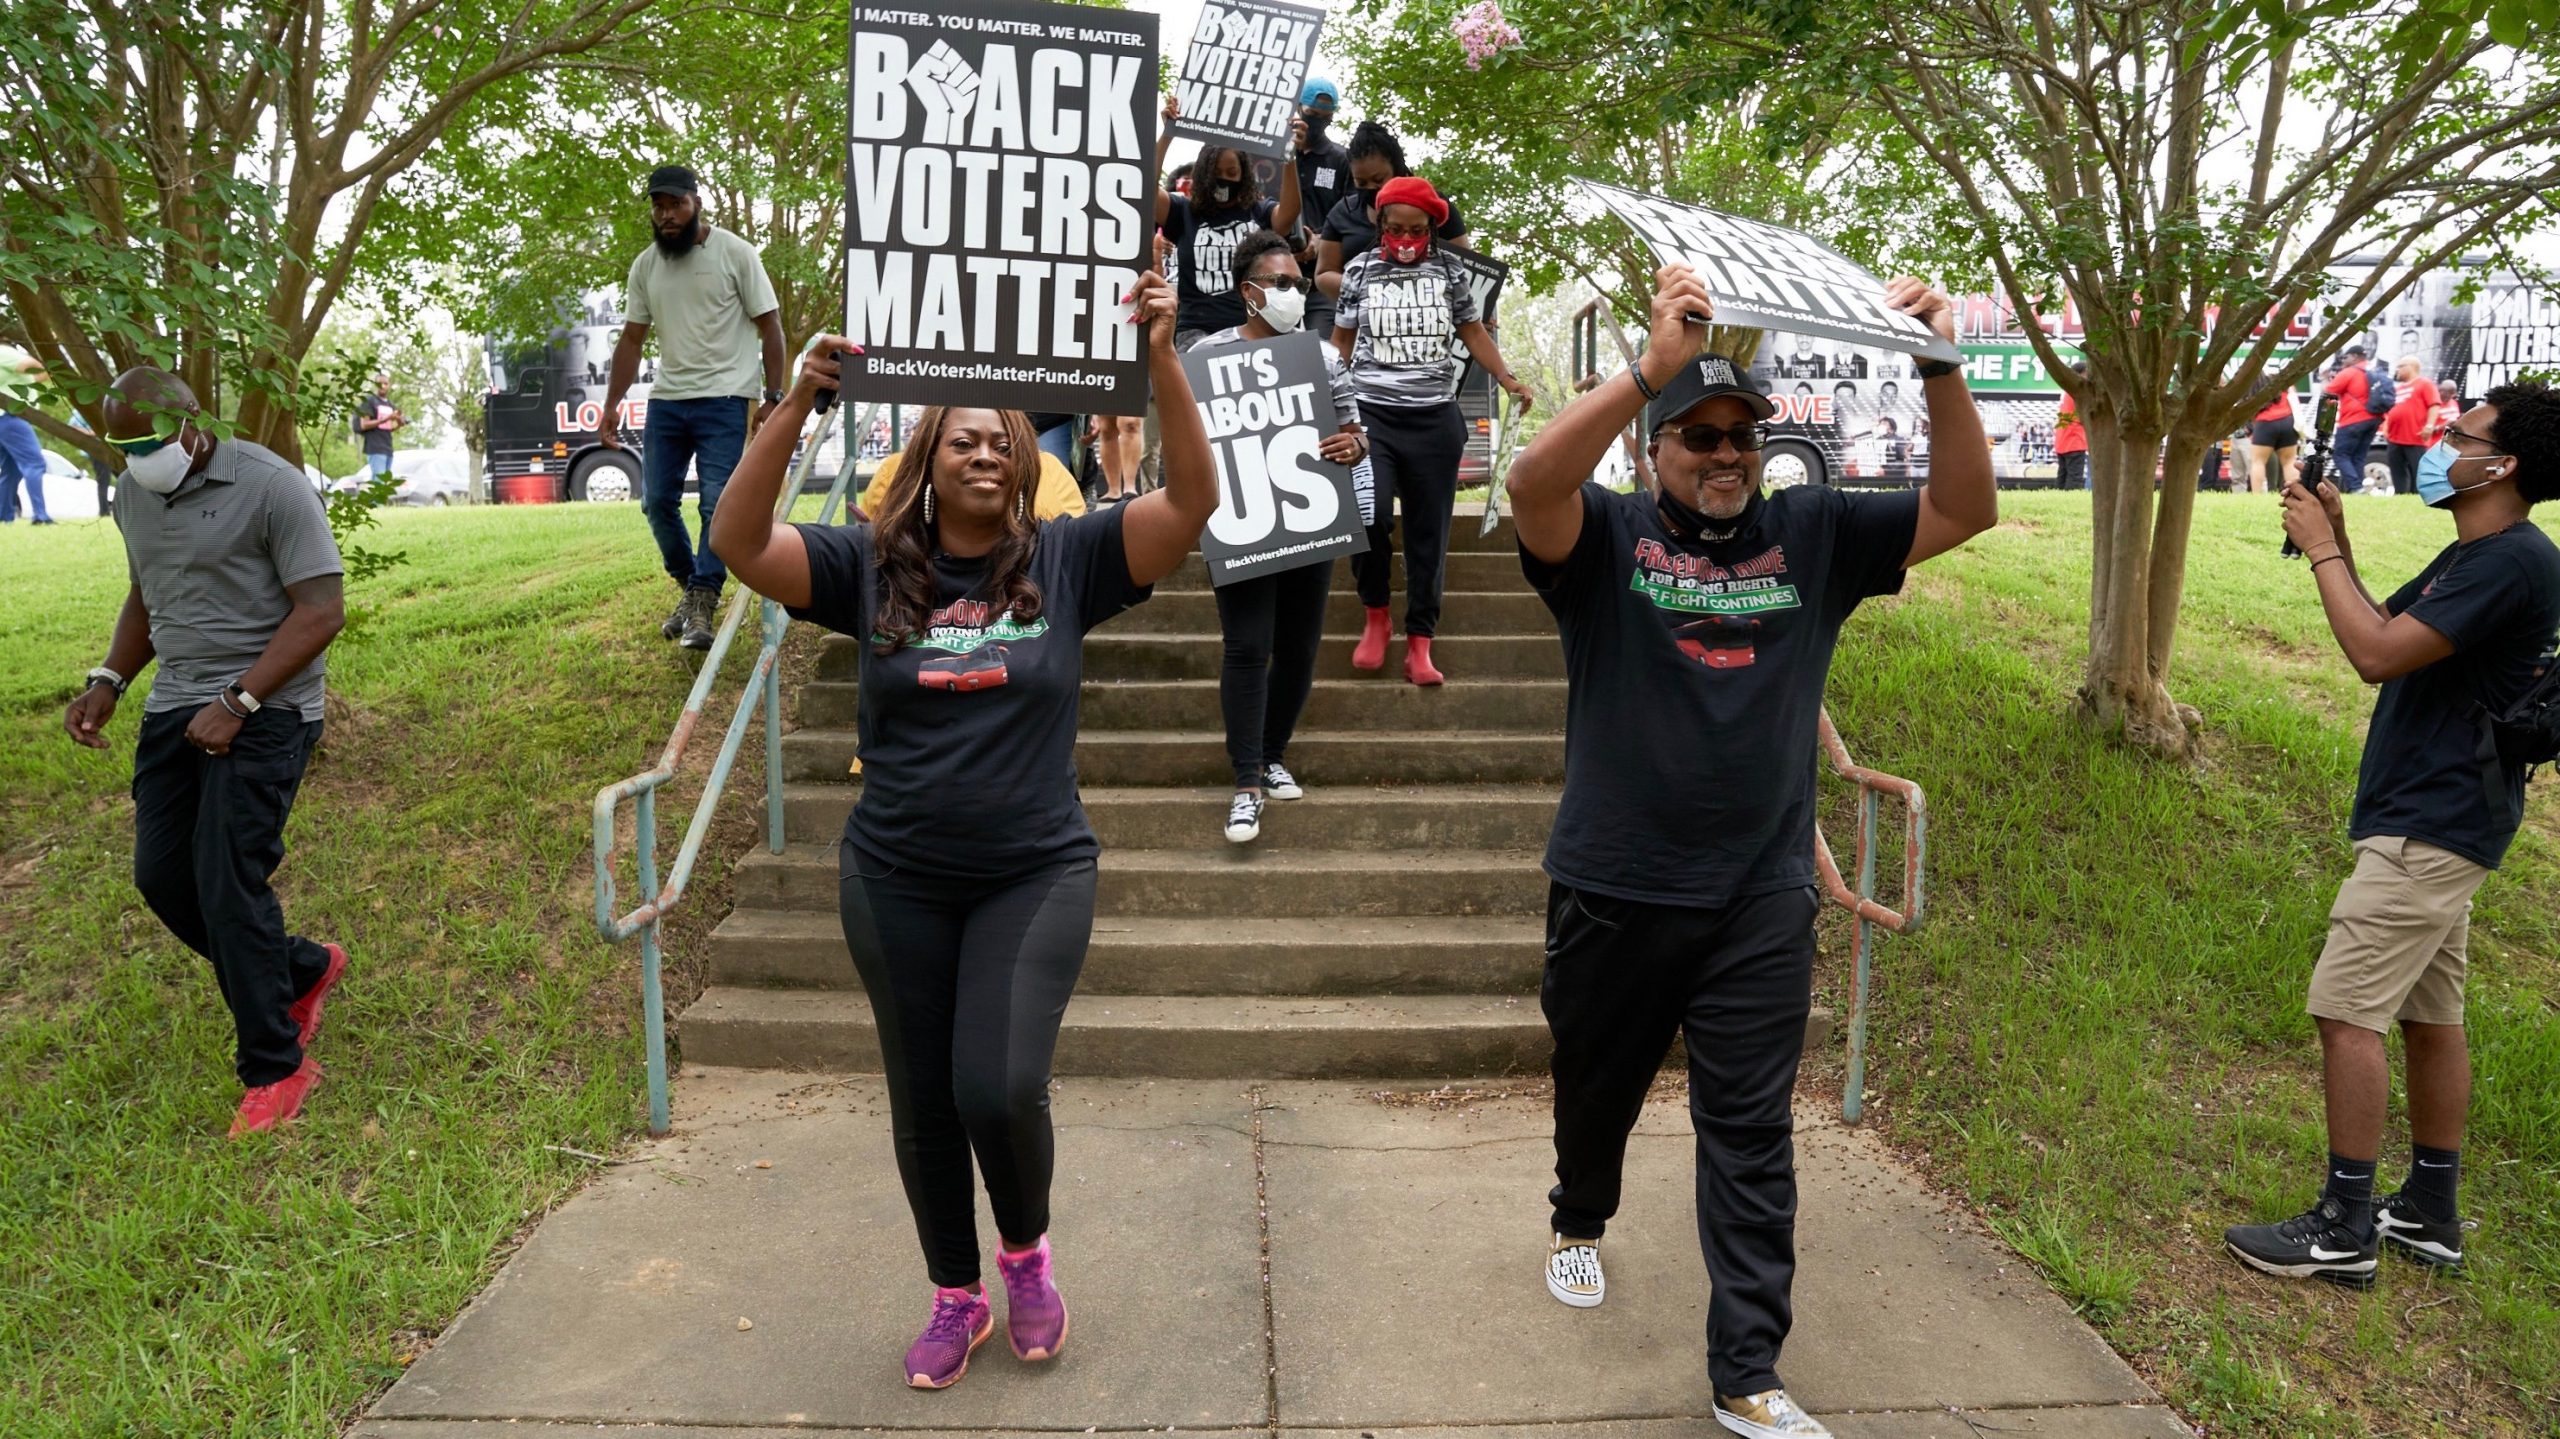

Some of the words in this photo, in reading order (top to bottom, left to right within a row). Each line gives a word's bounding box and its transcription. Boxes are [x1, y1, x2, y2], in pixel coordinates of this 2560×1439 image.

[855, 7, 860, 20] I
[864, 8, 933, 27] MATTER.
[937, 14, 974, 31] YOU
[977, 18, 1045, 37] MATTER.
[1049, 25, 1075, 41] WE
[1079, 28, 1146, 47] MATTER.
[1185, 42, 1305, 99] VOTERS
[1177, 80, 1293, 138] MATTER
[851, 142, 1143, 261] VOTERS
[1193, 245, 1236, 271] VOT
[1195, 270, 1234, 294] MAT
[846, 248, 1140, 362] MATTER
[1368, 306, 1449, 336] VOTERS
[1711, 296, 1928, 347] lackVotersMatterFund.org
[1372, 336, 1447, 363] MATTER
[866, 357, 1116, 391] BlackVotersMatterFund.org
[1207, 348, 1280, 395] IT'S
[1961, 354, 2004, 380] HE
[1758, 392, 1836, 424] OVE
[1207, 425, 1340, 546] US
[1224, 533, 1353, 570] BlackVotersMatterFund.org
[1732, 545, 1788, 578] RIDE
[1649, 571, 1674, 586] FOR
[1677, 578, 1724, 594] VONG
[1726, 576, 1778, 593] RIGHTS
[1710, 590, 1793, 610] CONTINUES
